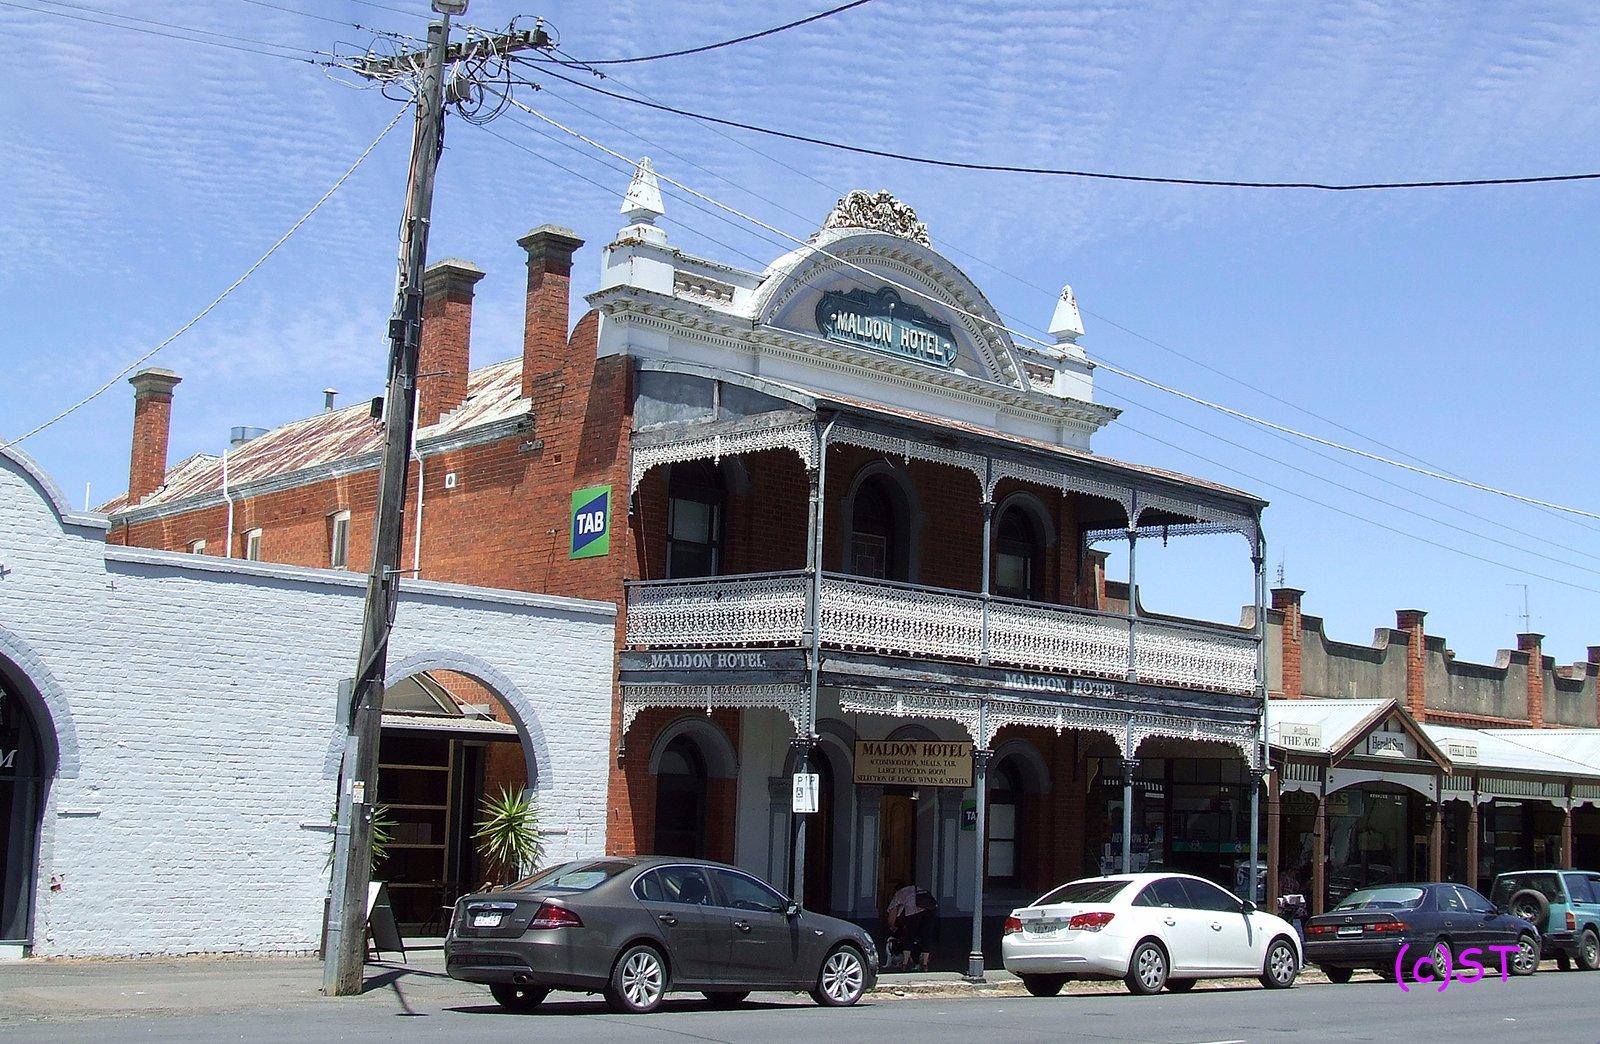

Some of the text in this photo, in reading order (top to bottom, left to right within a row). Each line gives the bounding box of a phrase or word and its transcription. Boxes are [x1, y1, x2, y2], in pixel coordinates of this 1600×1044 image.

[837, 310, 944, 355] MALDON HOTEL
[577, 511, 604, 535] TAB
[651, 652, 766, 668] MALDON HOTEL
[1005, 673, 1117, 697] MALDON HOTEL
[862, 743, 967, 757] MALDON HOTEL
[1282, 735, 1320, 748] THE AGE
